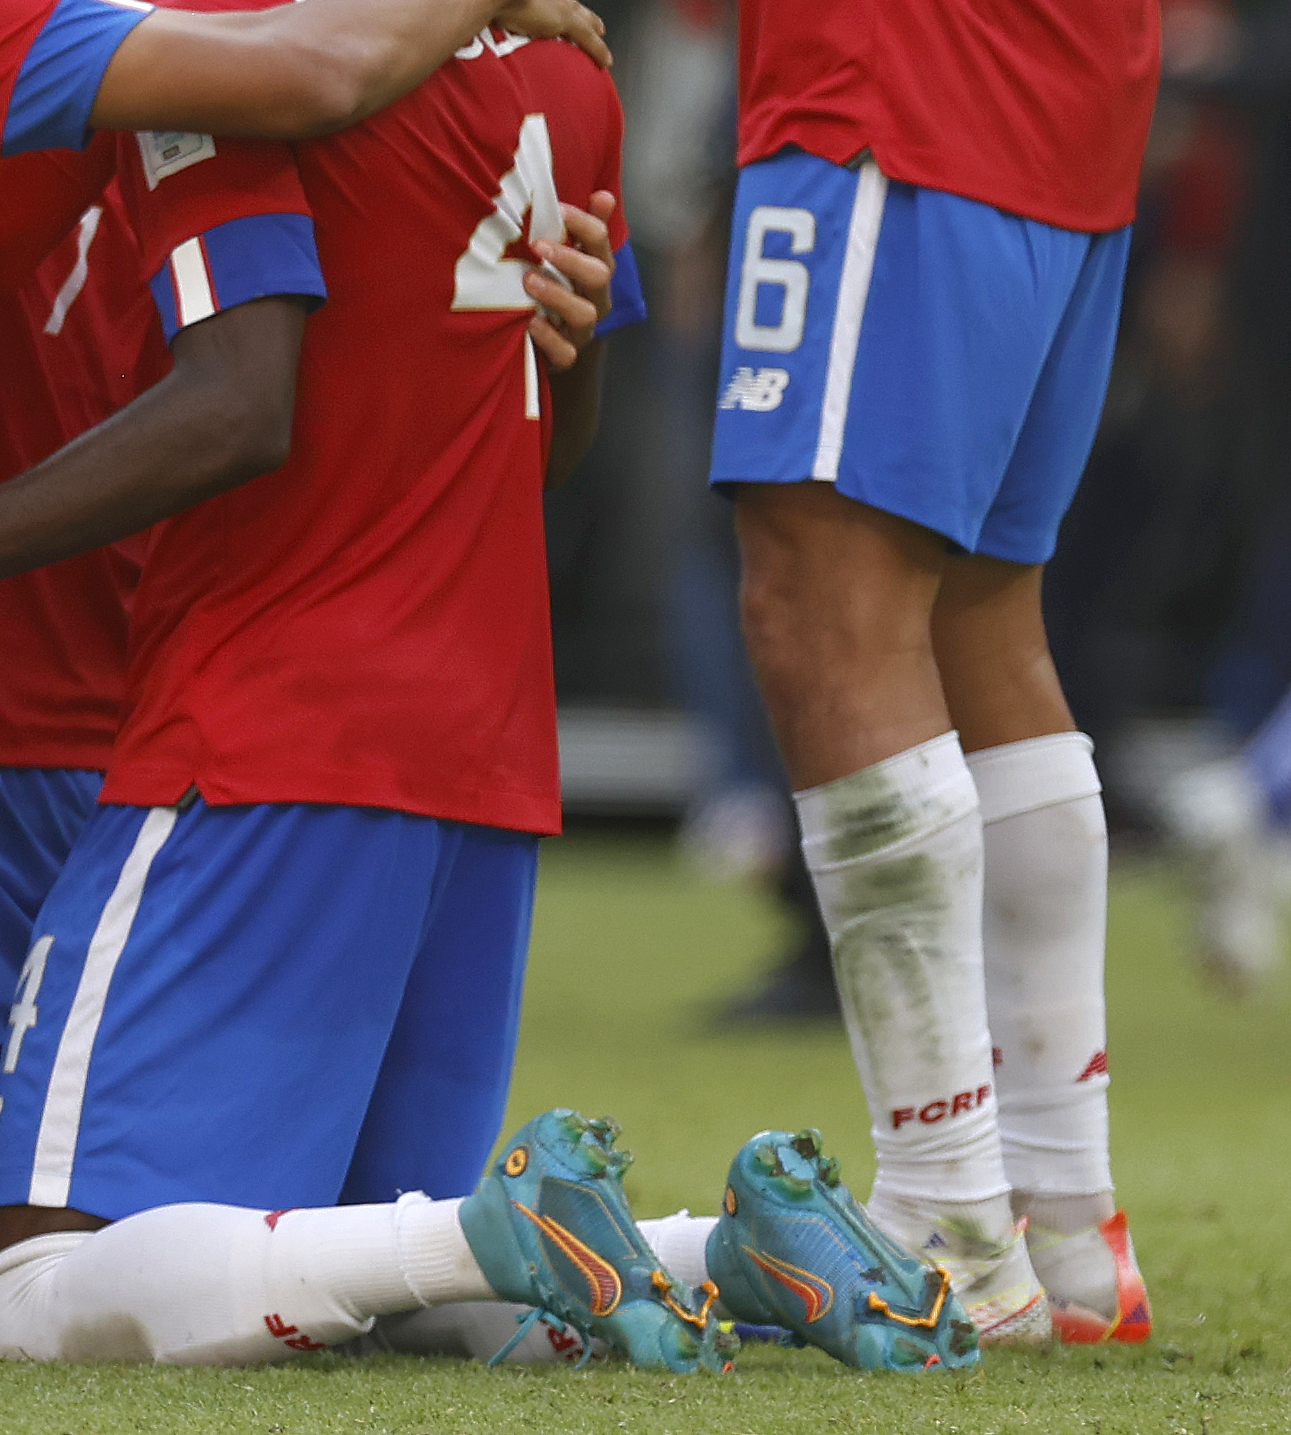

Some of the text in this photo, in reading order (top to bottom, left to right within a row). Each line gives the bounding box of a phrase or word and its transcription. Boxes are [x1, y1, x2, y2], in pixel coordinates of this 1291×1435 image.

[450, 113, 574, 420] 4
[734, 204, 817, 353] 6
[4, 934, 56, 1074] 4
[891, 1084, 990, 1130] FCRF
